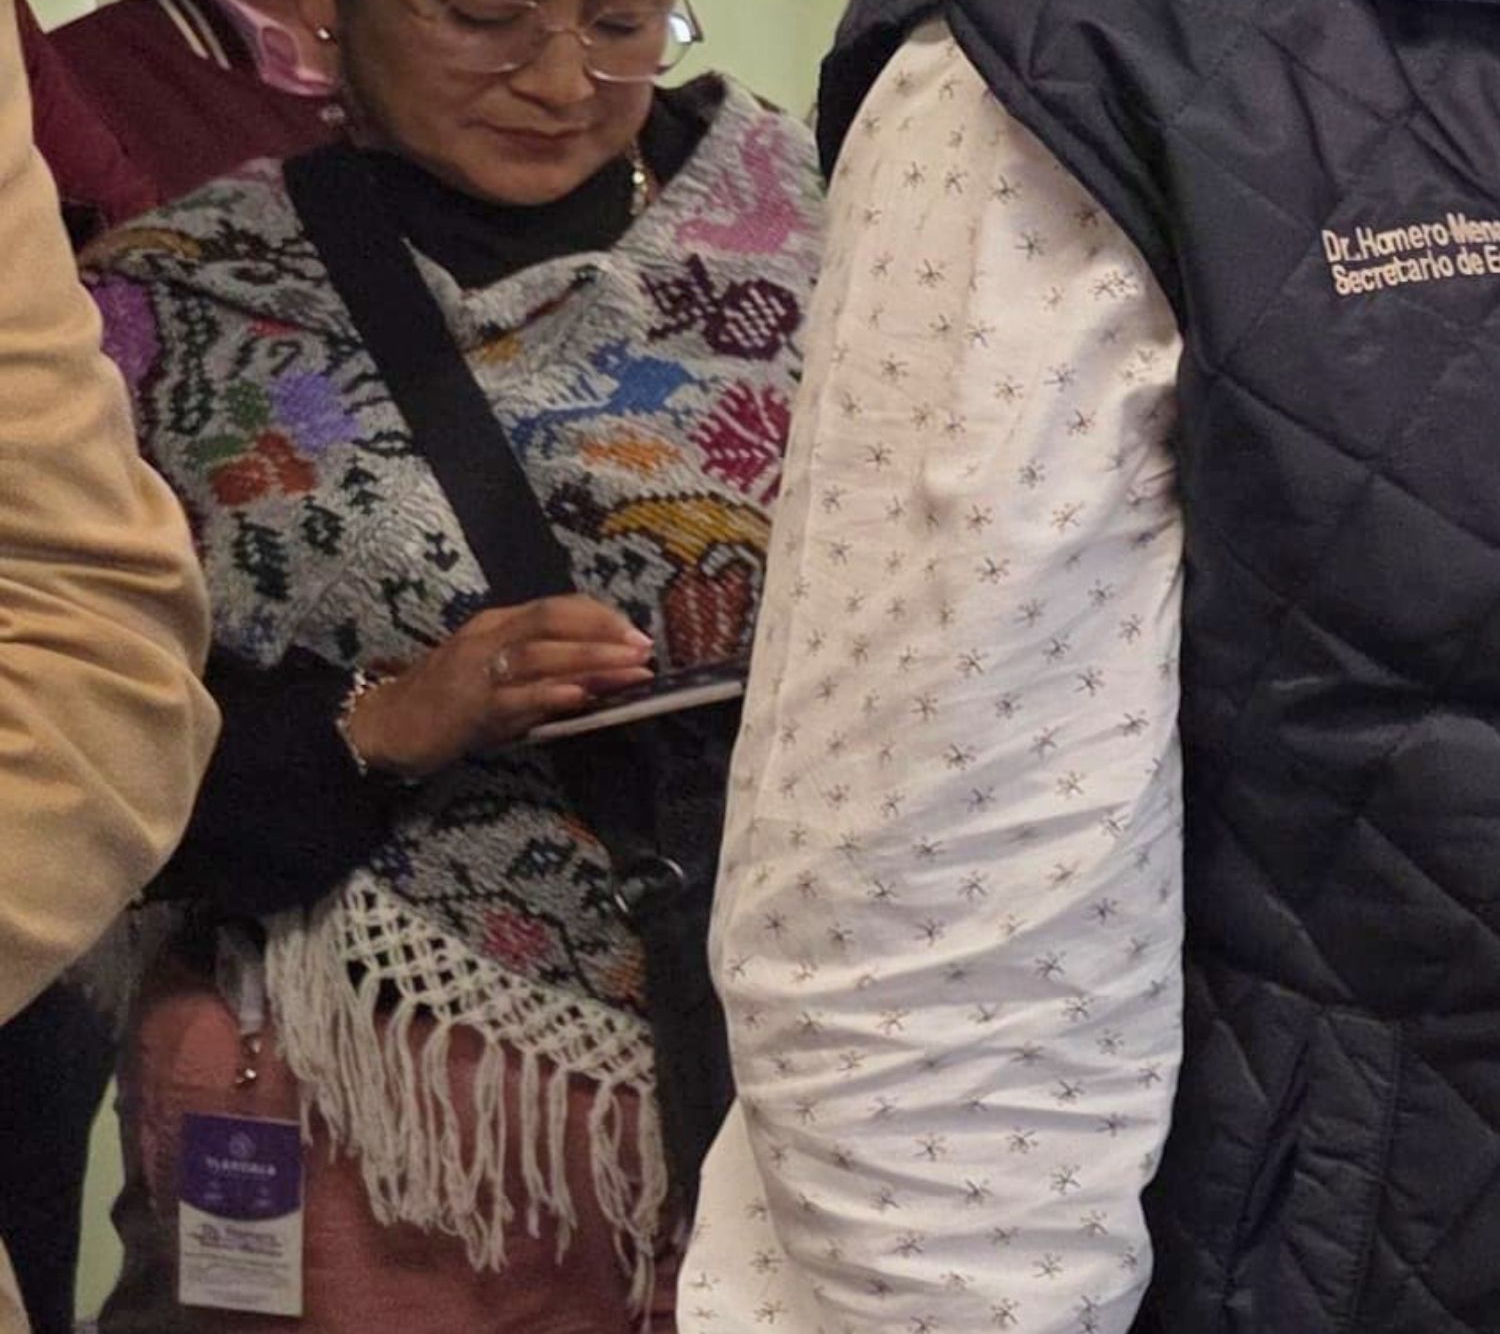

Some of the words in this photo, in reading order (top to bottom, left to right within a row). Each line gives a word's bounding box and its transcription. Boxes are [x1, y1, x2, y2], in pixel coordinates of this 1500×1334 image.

[1356, 221, 1449, 260] Homero
[1331, 253, 1454, 297] Secretario
[1456, 249, 1485, 275] de
